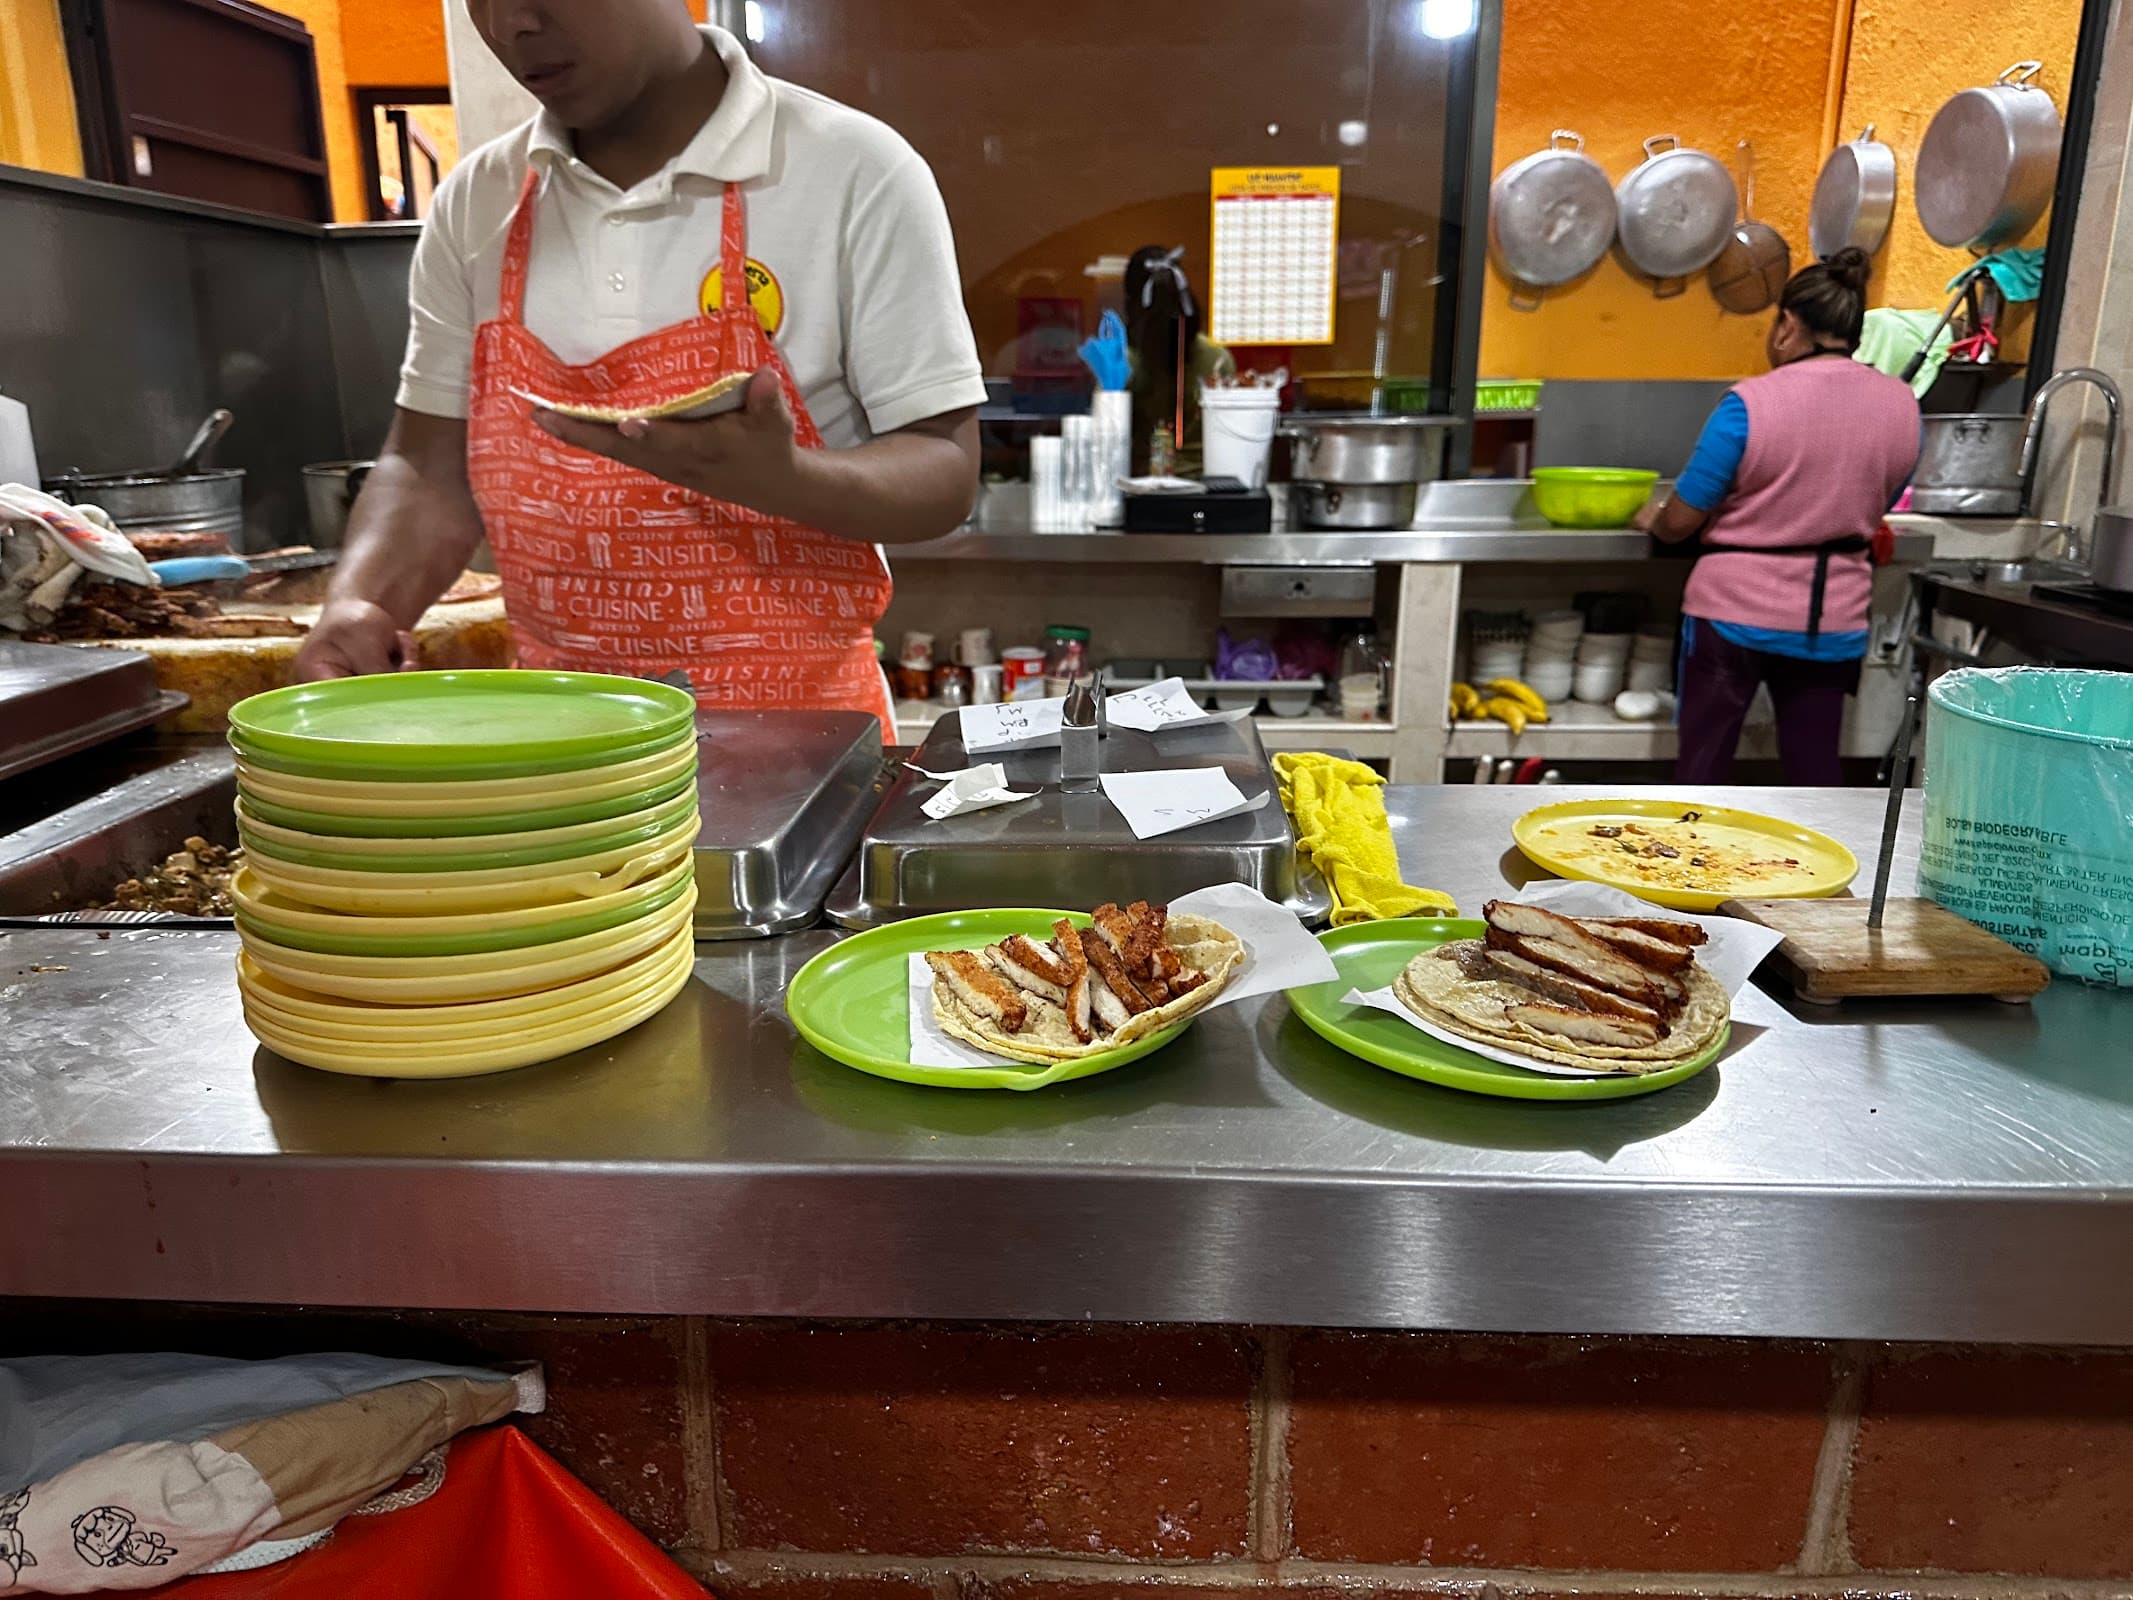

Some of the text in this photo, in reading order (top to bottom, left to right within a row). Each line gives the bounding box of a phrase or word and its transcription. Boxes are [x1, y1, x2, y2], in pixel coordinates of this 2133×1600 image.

[632, 543, 738, 567] CUISINE
[558, 575, 675, 598] CUISINE
[711, 577, 829, 599] CUISINE
[568, 595, 827, 622] CUISINE CUISINE
[595, 631, 851, 657] CUISINE CUISINE
[722, 680, 824, 702] CUISINE
